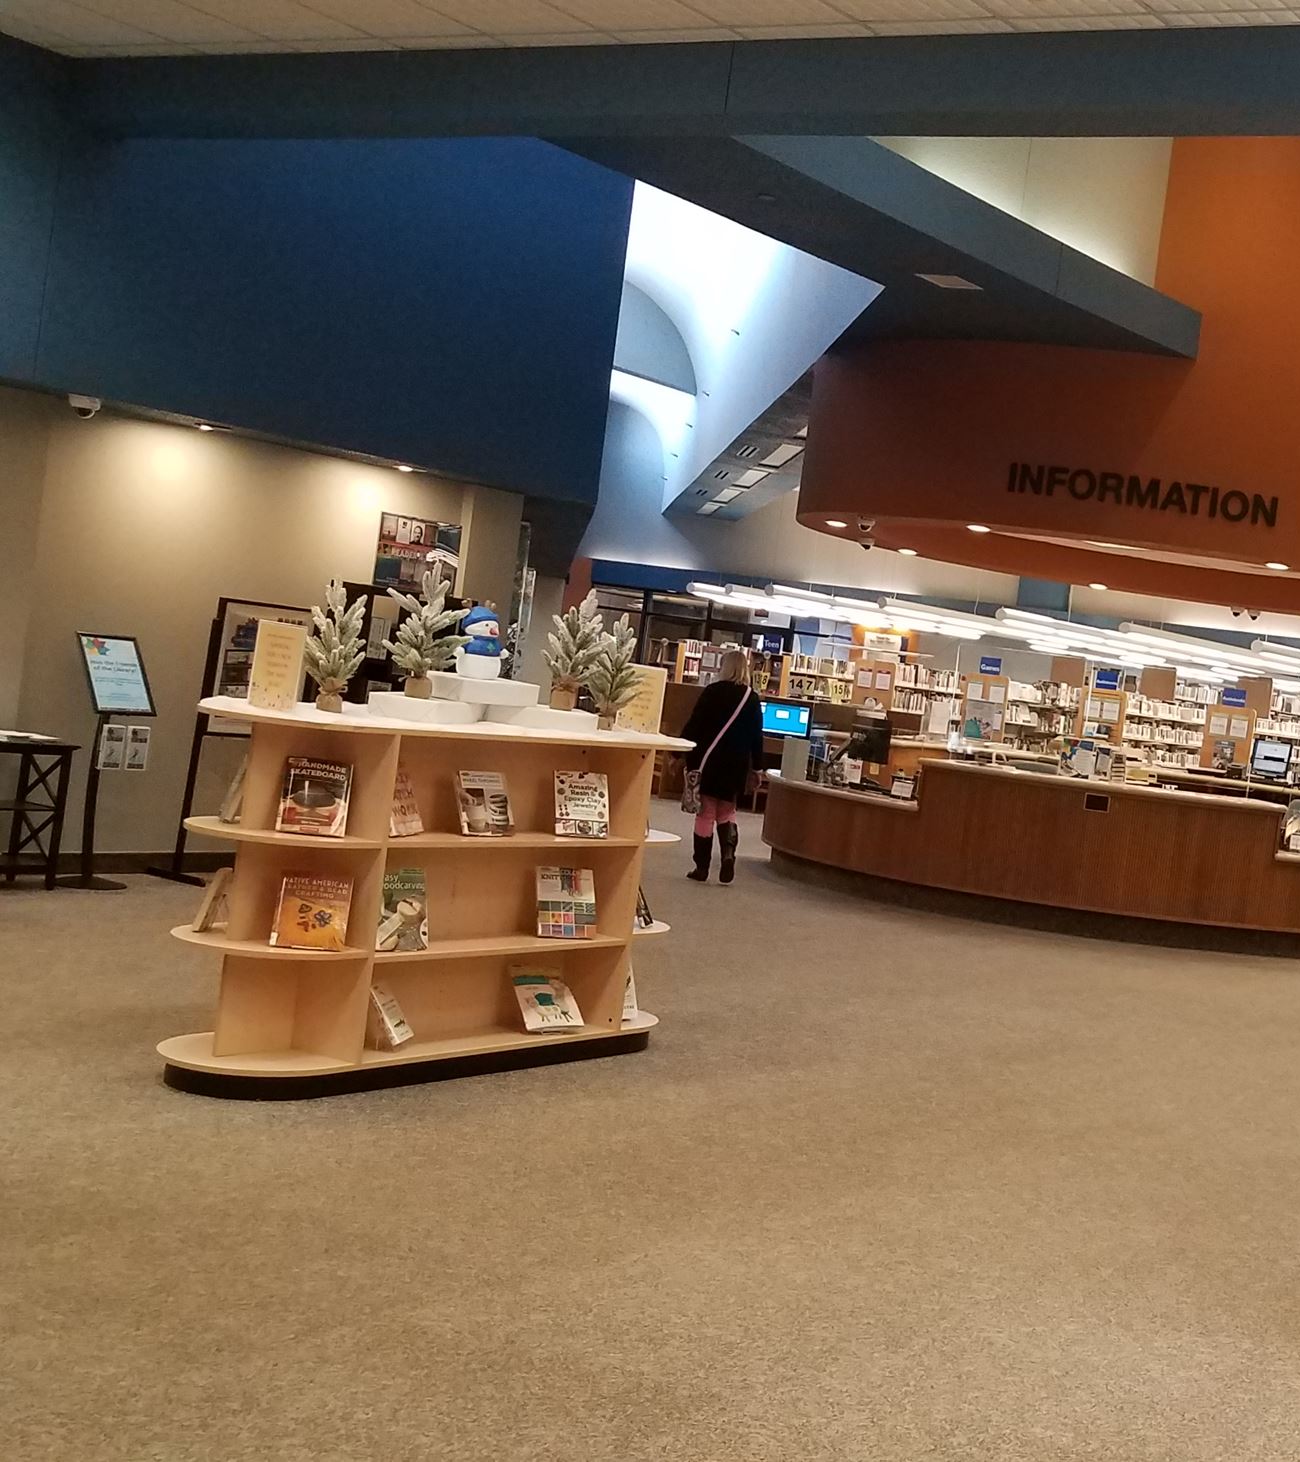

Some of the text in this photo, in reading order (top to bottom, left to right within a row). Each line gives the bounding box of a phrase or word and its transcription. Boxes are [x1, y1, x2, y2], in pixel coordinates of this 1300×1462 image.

[1007, 462, 1279, 527] INFORMATION
[764, 639, 779, 649] Teen
[981, 663, 1000, 672] Games
[568, 783, 598, 792] Amazing
[564, 795, 601, 805] Epoxy Clay
[573, 802, 597, 810] Jewelry
[384, 873, 399, 883] asy
[312, 879, 350, 889] AMERICAN
[383, 879, 425, 891] oodcarving
